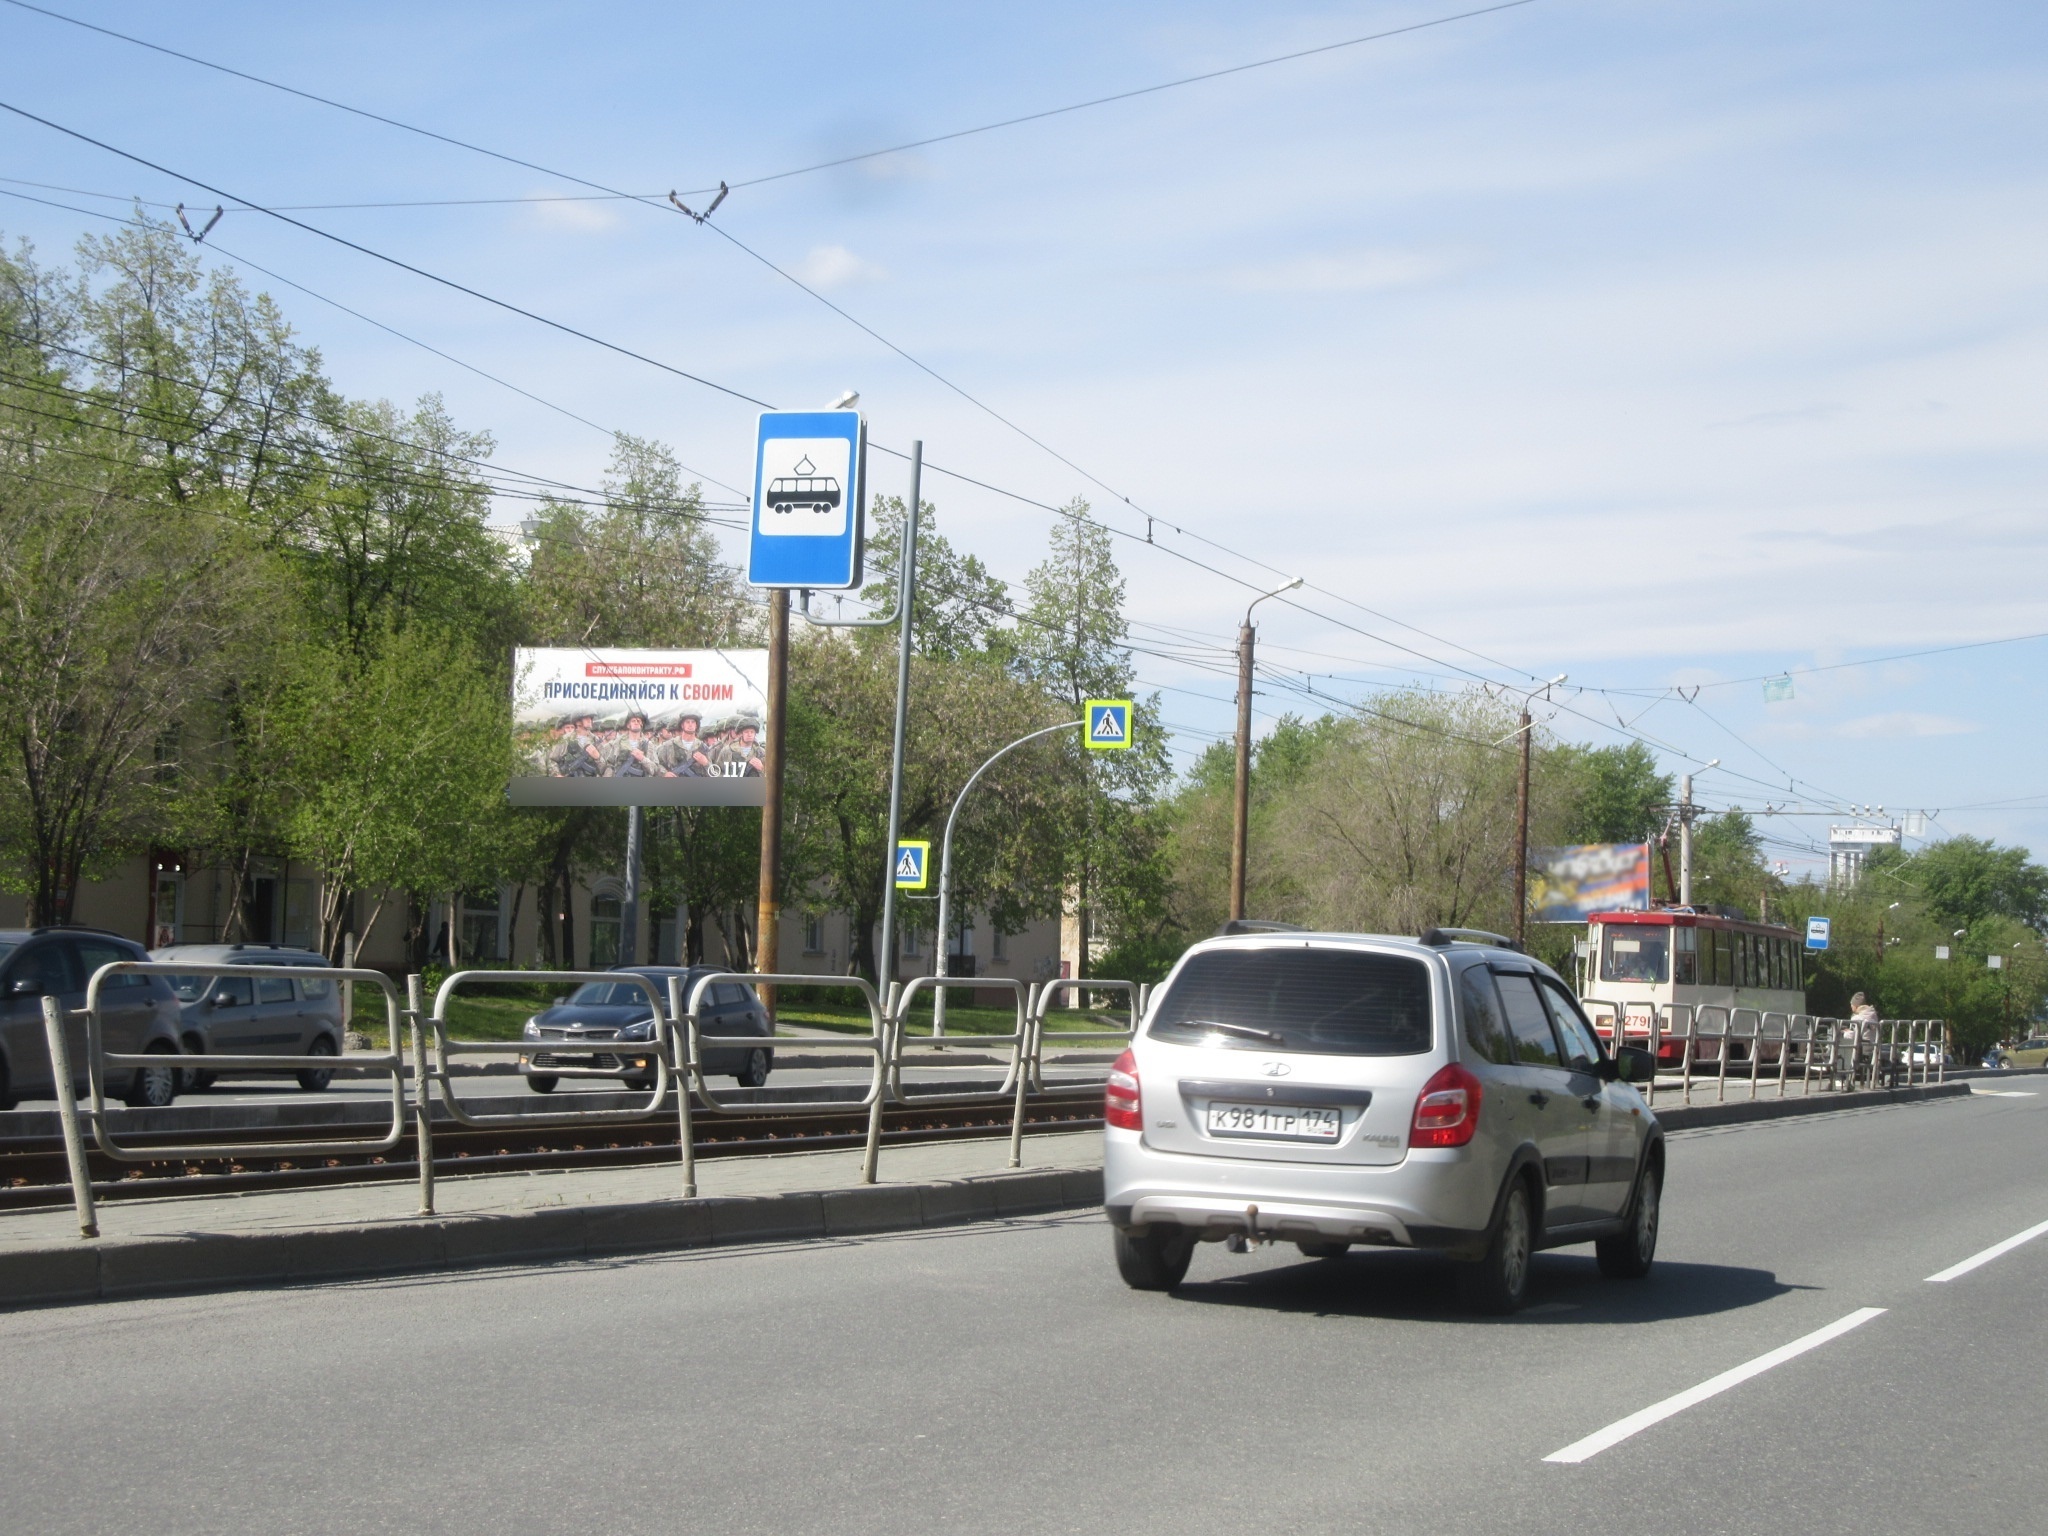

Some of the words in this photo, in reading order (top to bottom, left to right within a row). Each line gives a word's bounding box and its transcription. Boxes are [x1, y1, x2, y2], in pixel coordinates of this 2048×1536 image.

[592, 665, 686, 675] СЛУЖБАПОКОНТРАКТУ.РФ
[544, 680, 665, 701] ПРИСОЕДИНЯЙСЯ
[670, 683, 679, 700] К
[683, 684, 734, 701] СВОИМ
[723, 761, 747, 777] 117
[1302, 1110, 1336, 1128] 174
